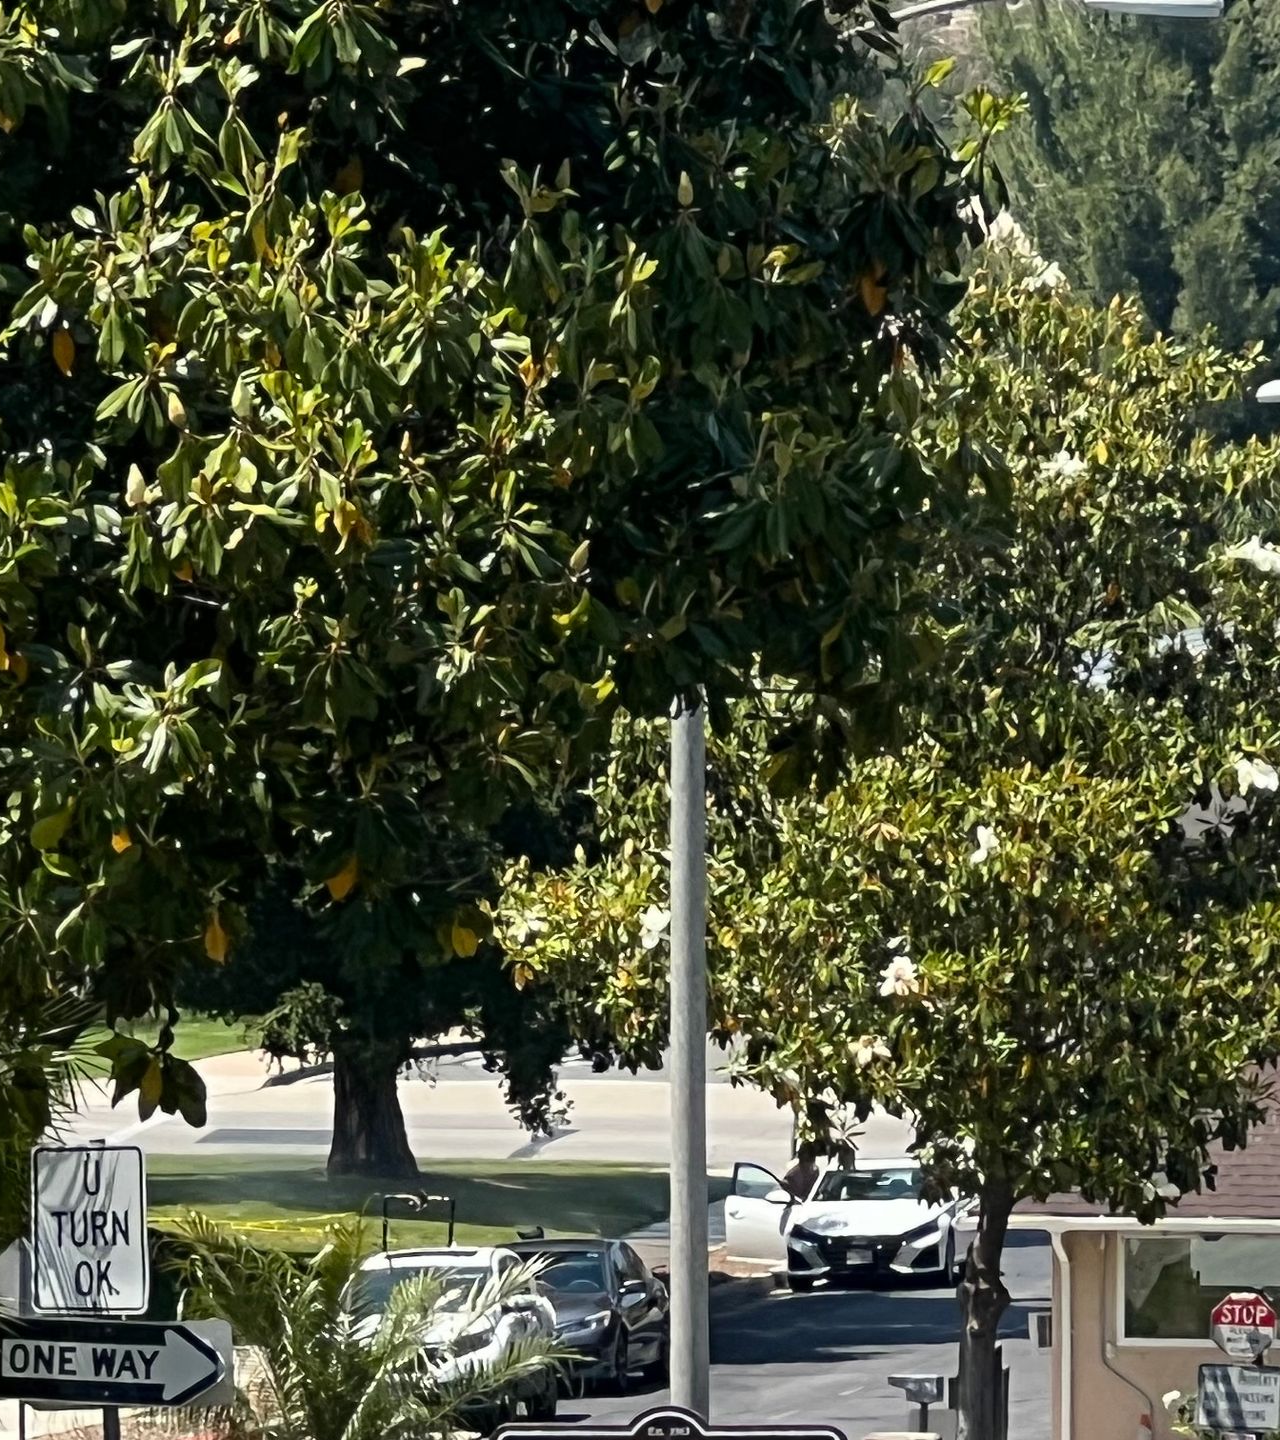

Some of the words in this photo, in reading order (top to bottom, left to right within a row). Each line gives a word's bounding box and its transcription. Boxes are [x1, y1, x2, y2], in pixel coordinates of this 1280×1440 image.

[82, 1152, 102, 1197] U
[50, 1209, 130, 1248] TURN
[74, 1259, 120, 1298] OK
[1219, 1303, 1270, 1325] STOP
[8, 1343, 77, 1377] ONE
[91, 1347, 160, 1380] WAY
